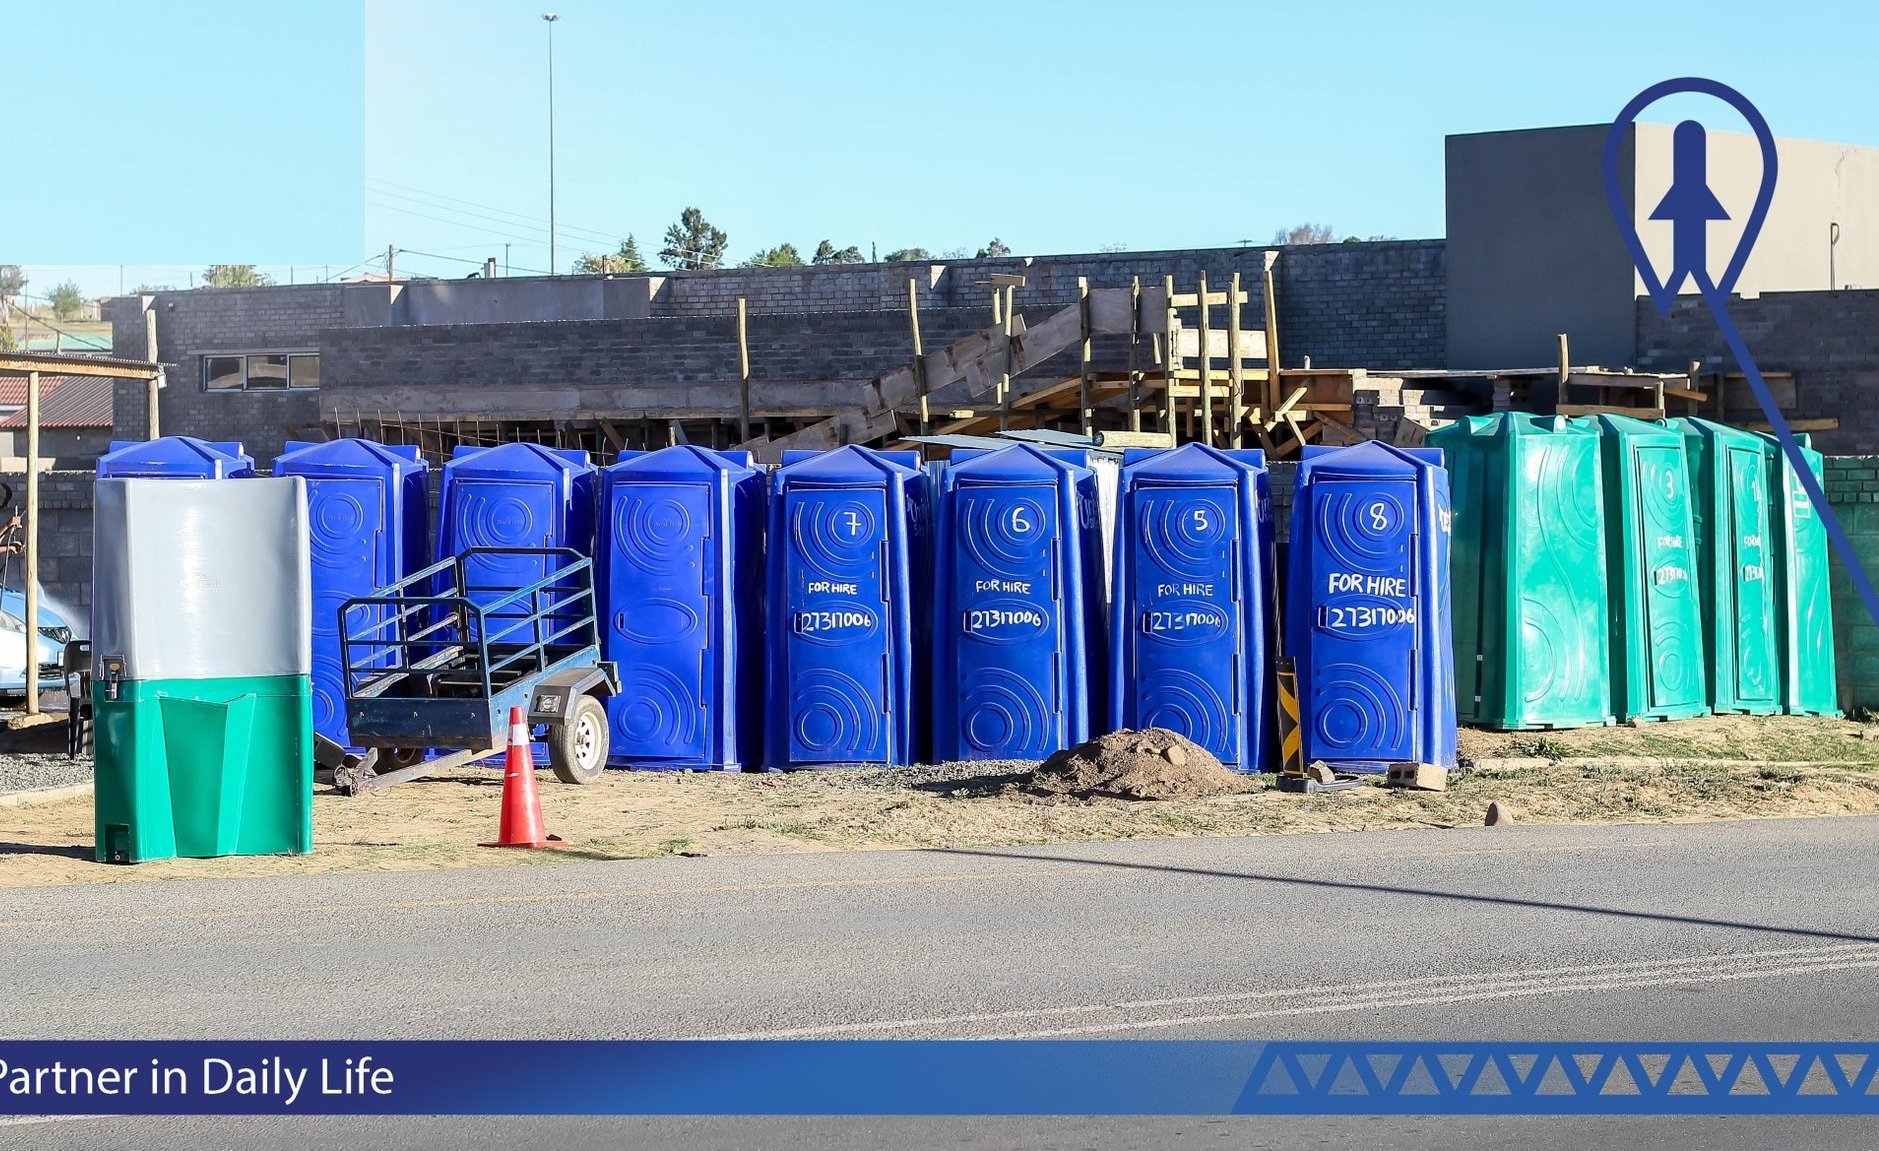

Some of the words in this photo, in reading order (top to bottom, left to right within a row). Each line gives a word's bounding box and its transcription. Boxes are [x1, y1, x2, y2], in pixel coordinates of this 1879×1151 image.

[1665, 469, 1674, 499] 3
[843, 511, 862, 536] 7
[1012, 506, 1031, 533] 6
[1193, 509, 1209, 531] 5
[1369, 502, 1388, 531] 8
[808, 581, 830, 594] FOR
[831, 582, 858, 595] HIRE
[975, 580, 1000, 593] FOR
[1002, 581, 1031, 595] HIRE
[1157, 583, 1181, 598] FOR
[1183, 583, 1214, 597] HIRE
[1328, 572, 1363, 594] FOR
[1366, 575, 1407, 597] HIRE
[802, 611, 872, 632] 27317006
[971, 609, 1042, 629] 27317006
[1331, 606, 1416, 628] 27317006
